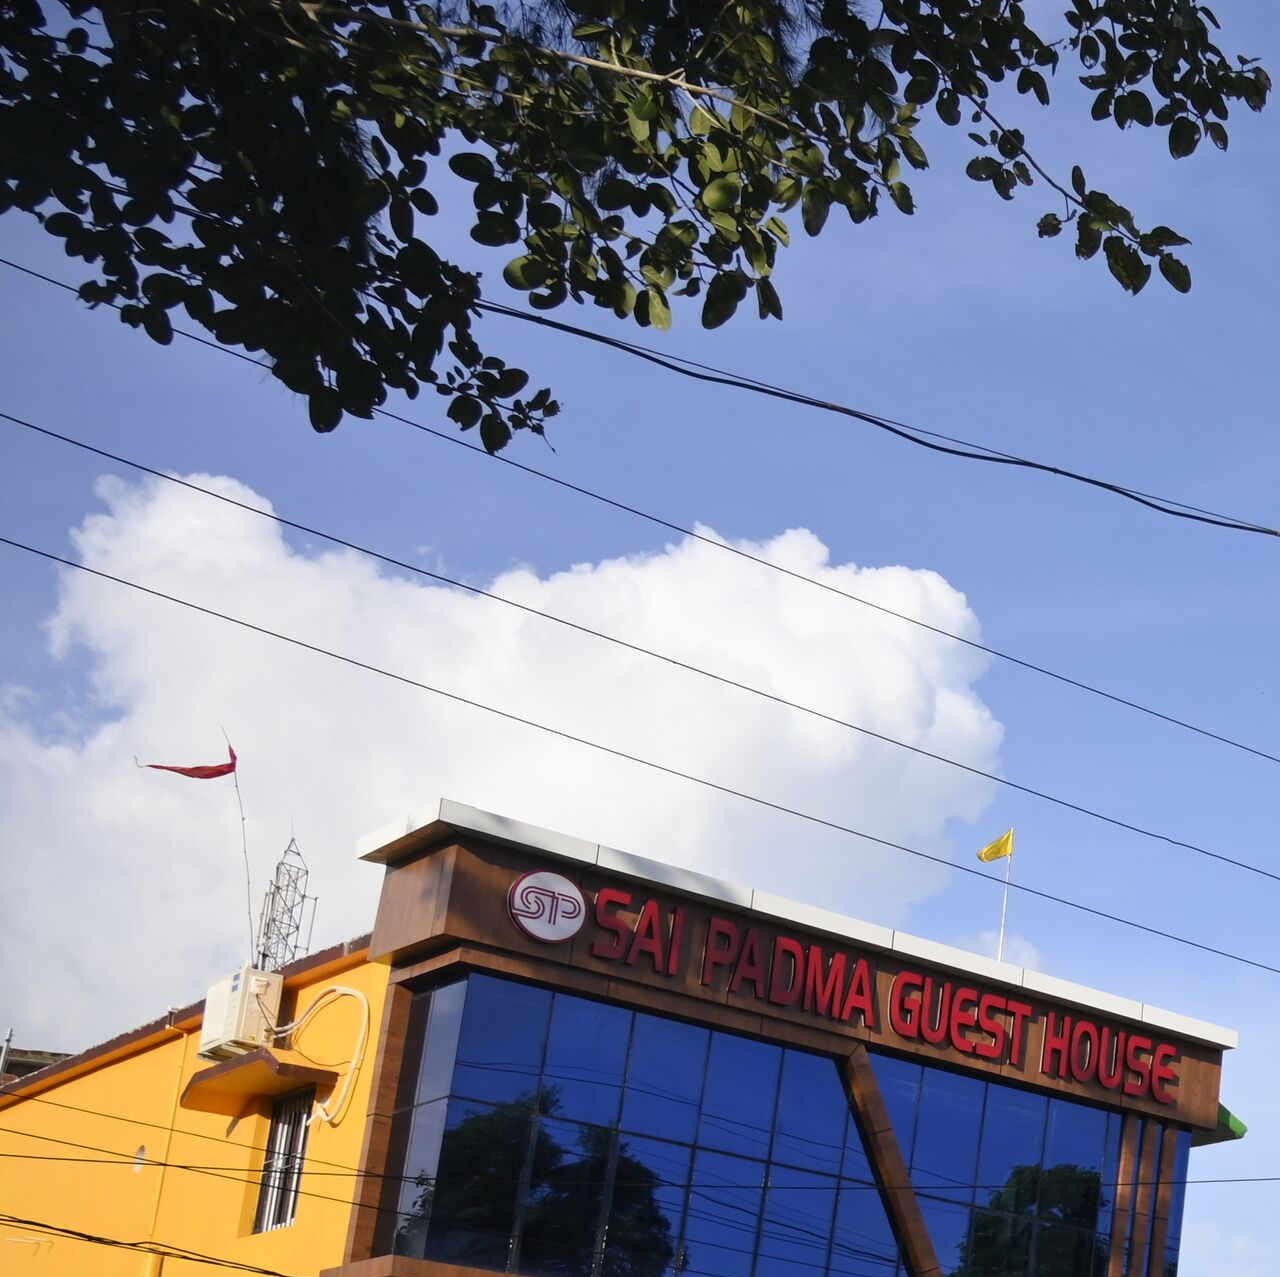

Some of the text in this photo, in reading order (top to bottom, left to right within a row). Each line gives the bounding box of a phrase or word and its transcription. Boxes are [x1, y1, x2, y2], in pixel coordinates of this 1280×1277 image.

[592, 887, 1177, 1104] SAI PADMA GUEST HOUSE
